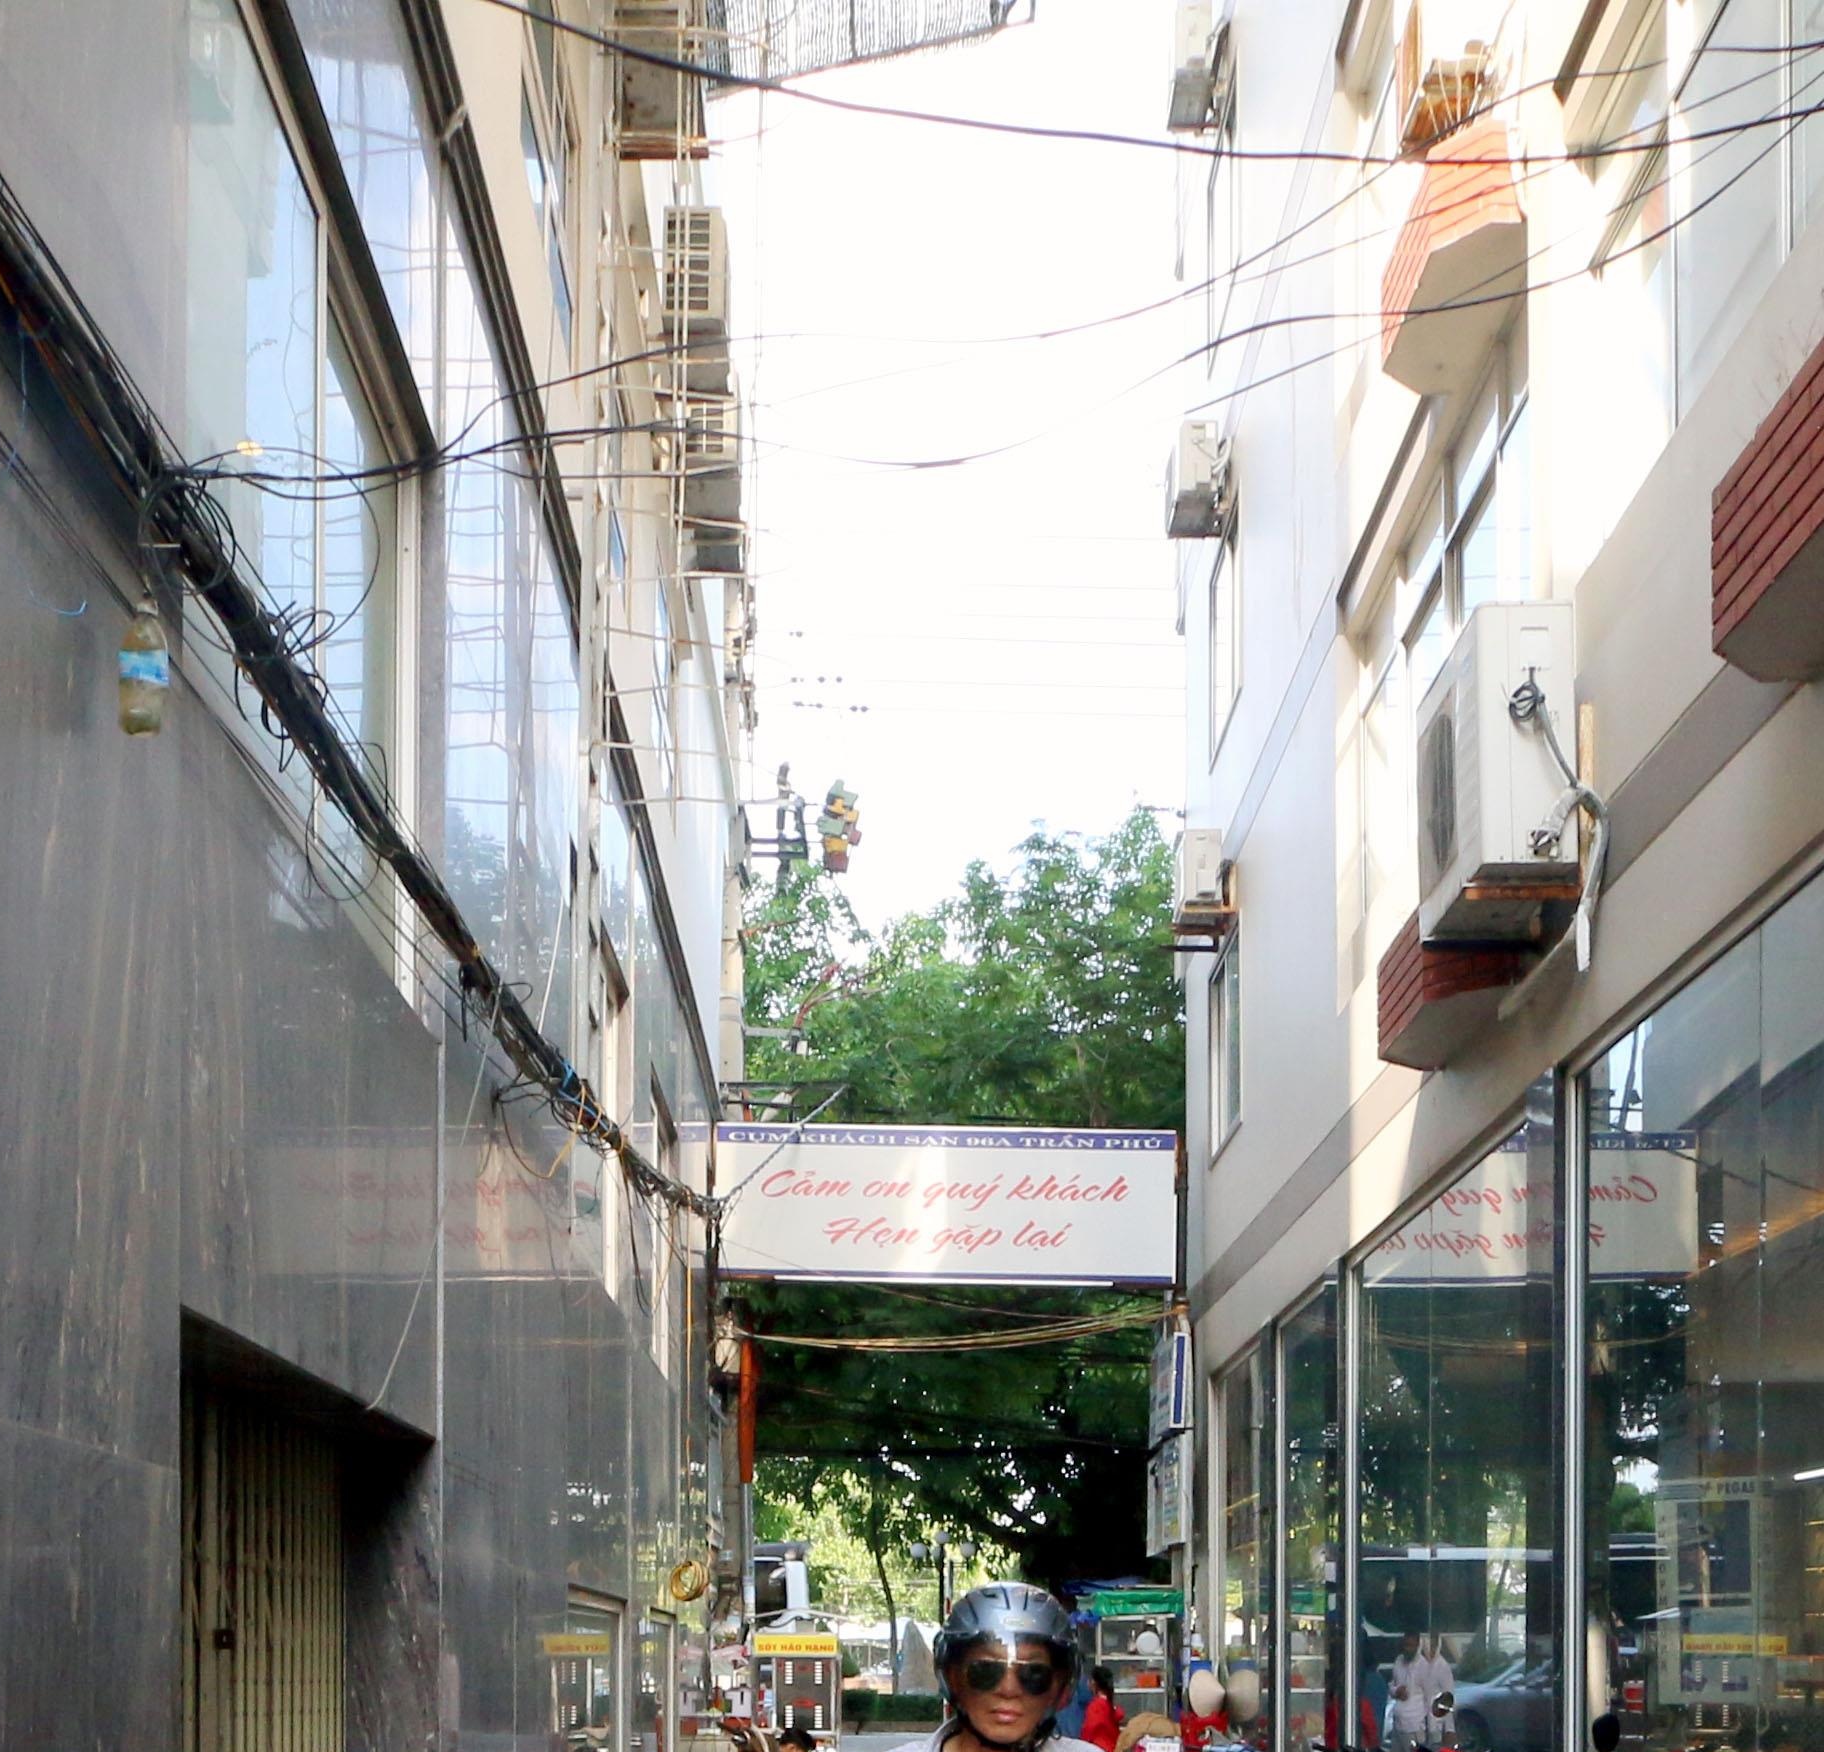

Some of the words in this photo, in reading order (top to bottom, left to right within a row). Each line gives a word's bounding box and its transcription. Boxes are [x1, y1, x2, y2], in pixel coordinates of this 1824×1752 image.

[965, 1137, 1013, 1147] 96A
[761, 1168, 853, 1198] Cảm
[922, 1173, 1004, 1212] quý
[1006, 1173, 1131, 1202] khách
[822, 1215, 920, 1249] Hẹn
[931, 1224, 1003, 1254] gặp
[1012, 1219, 1073, 1251] lại
